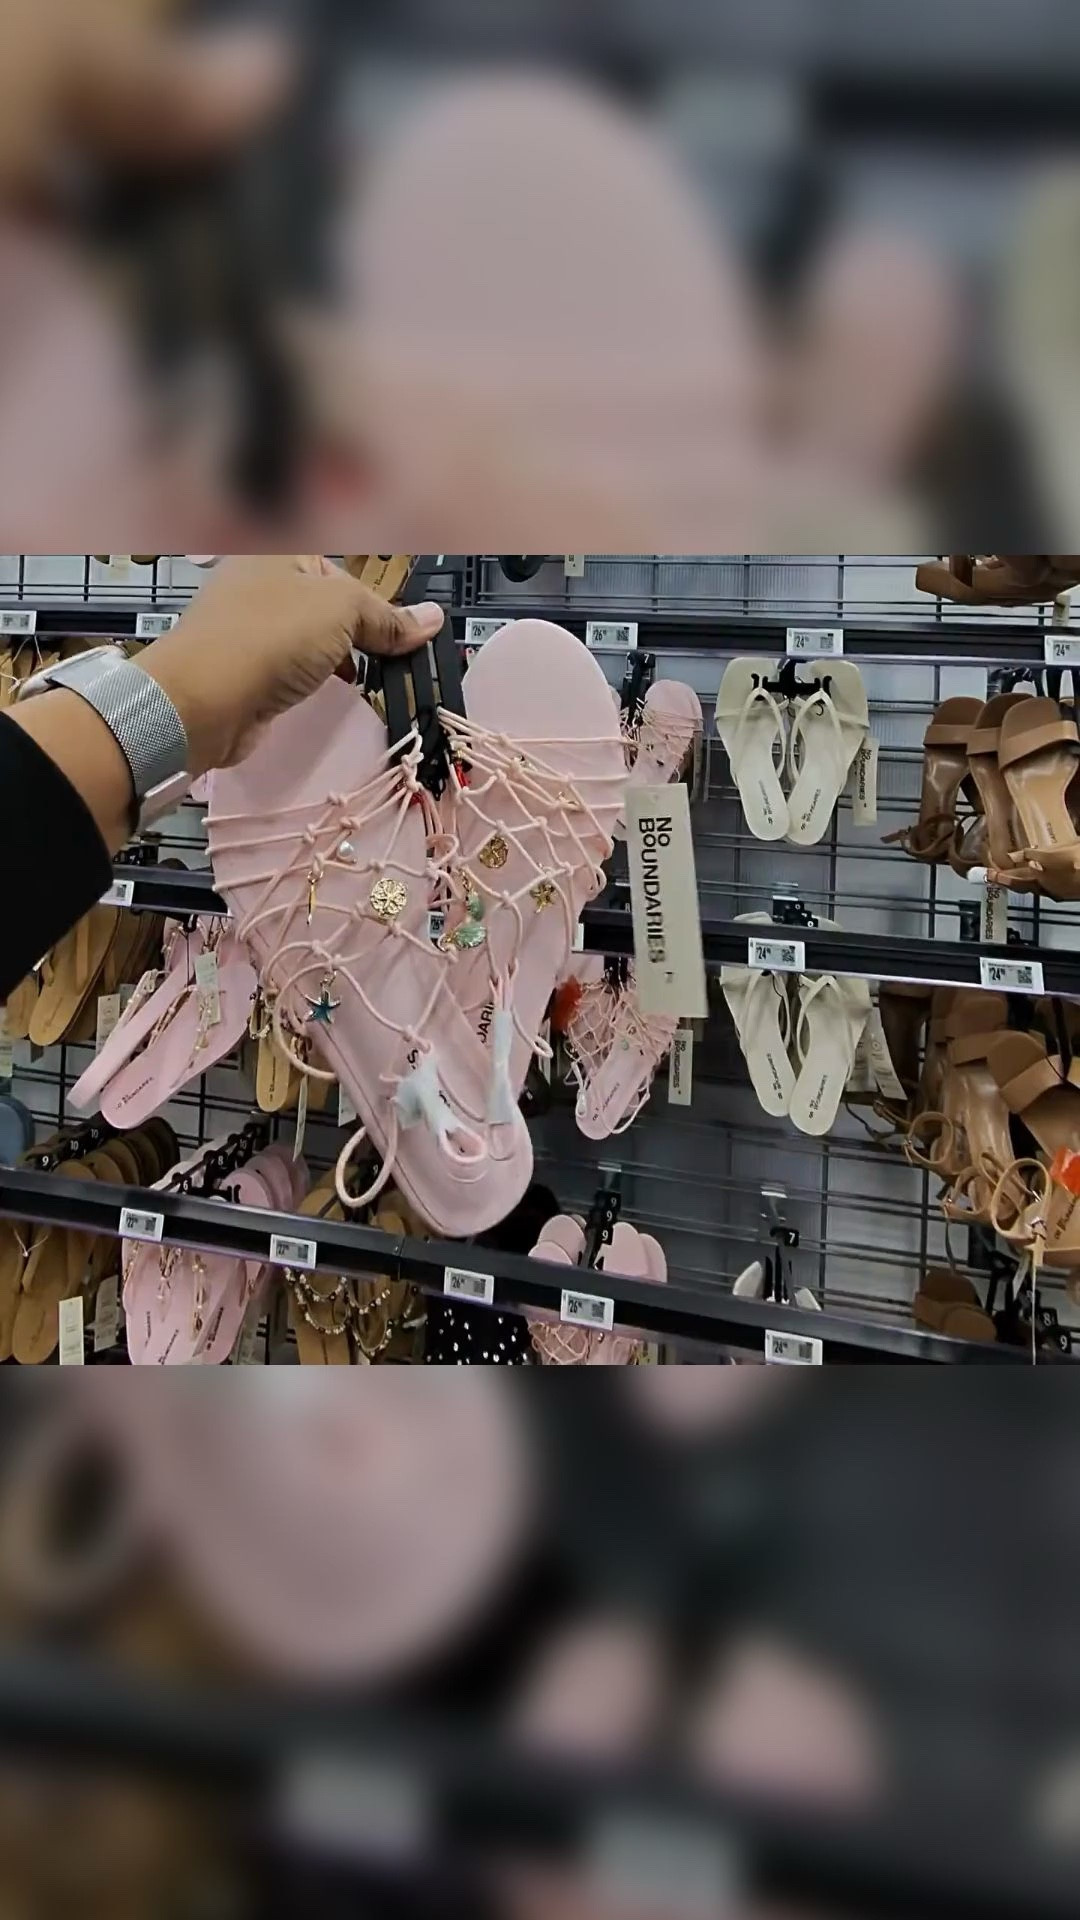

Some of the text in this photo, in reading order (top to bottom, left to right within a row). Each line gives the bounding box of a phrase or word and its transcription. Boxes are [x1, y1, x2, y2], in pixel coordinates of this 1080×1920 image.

[643, 654, 650, 664] 7
[655, 816, 673, 847] NO
[639, 818, 666, 964] BOUNDARIES
[90, 1129, 99, 1139] 10
[70, 1140, 79, 1151] 10
[41, 1156, 49, 1166] 9
[217, 1155, 224, 1166] 8
[182, 1179, 190, 1190] 6
[610, 1196, 618, 1207] 9
[606, 1209, 613, 1221] 9
[601, 1229, 609, 1241] 9
[788, 1232, 796, 1244] 7
[1042, 1312, 1051, 1326] 8
[1059, 1334, 1068, 1349] 9
